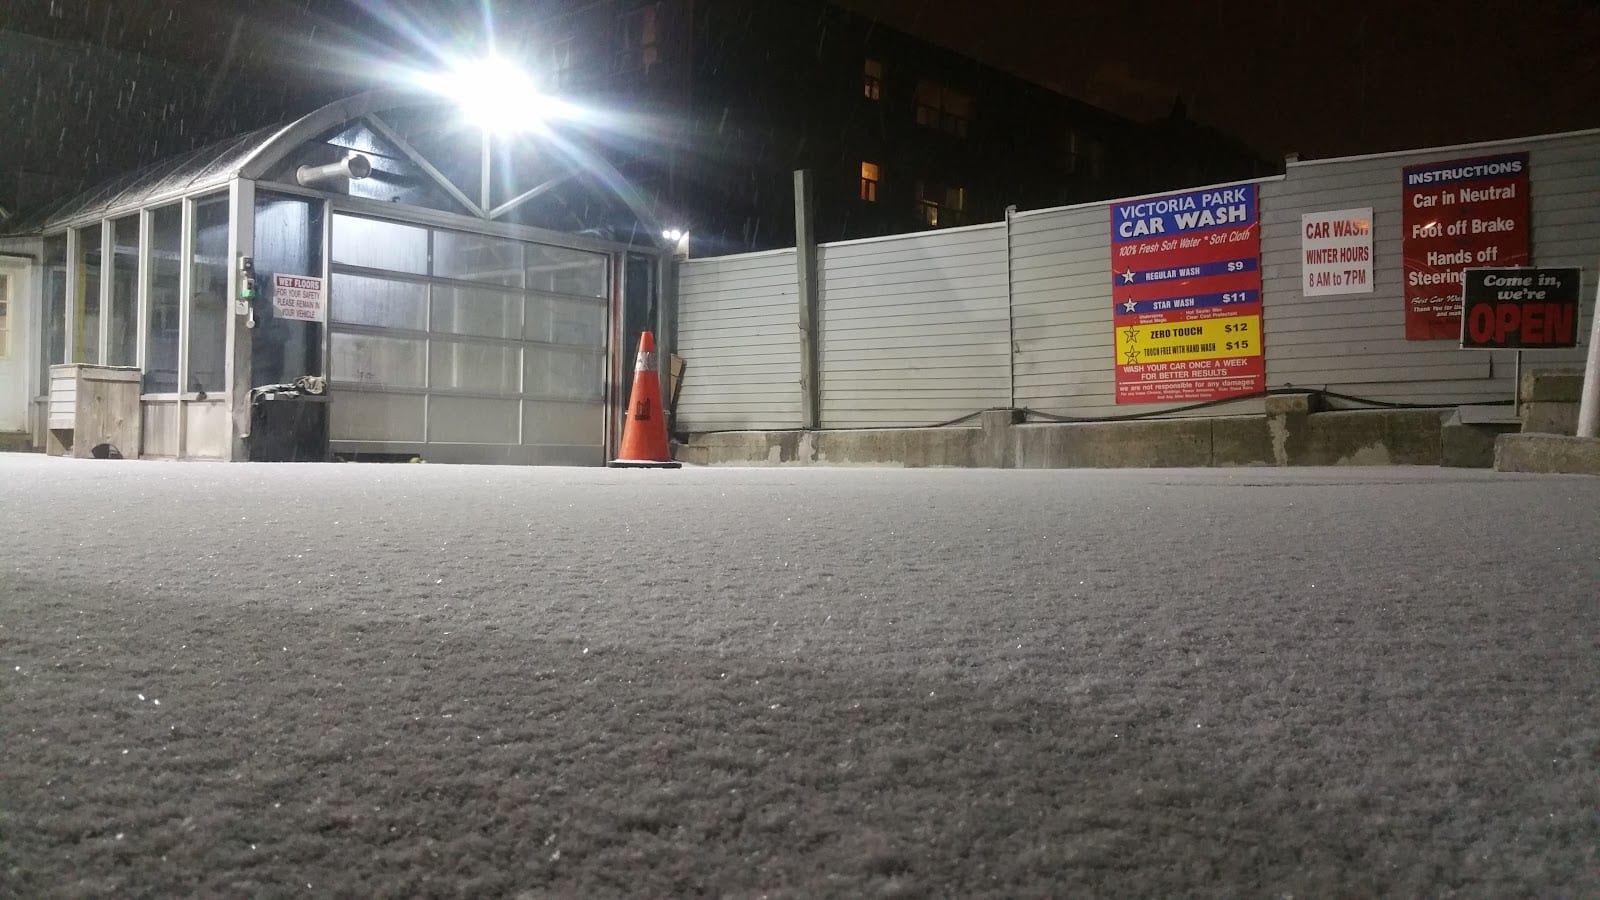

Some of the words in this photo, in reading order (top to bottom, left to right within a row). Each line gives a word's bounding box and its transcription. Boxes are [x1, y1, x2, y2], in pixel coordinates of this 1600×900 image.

[1408, 160, 1522, 184] INSTRUCTIONS
[1120, 196, 1196, 219] VICTORIA
[1202, 188, 1246, 207] PARK
[1413, 194, 1436, 208] Car
[1442, 190, 1455, 205] in
[1460, 184, 1516, 203] Neutral
[1119, 217, 1165, 238] CAR
[1174, 204, 1246, 230] WASH
[1306, 222, 1330, 240] CAR
[1333, 220, 1369, 237] WASH
[1412, 224, 1442, 239] Foot
[1447, 220, 1468, 236] off
[1472, 217, 1514, 234] Brake
[1119, 245, 1137, 257] 100%
[1138, 241, 1158, 254] Fresh
[1160, 240, 1178, 251] Soft
[1180, 238, 1201, 249] Water
[1209, 233, 1226, 245] Soft
[1229, 230, 1250, 242] Cloth
[1306, 248, 1338, 265] WINTER
[1340, 246, 1369, 263] HOURS
[1427, 250, 1472, 266] Hands
[1477, 246, 1498, 262] off
[1146, 269, 1176, 281] REGULAR
[1179, 267, 1200, 277] WASH
[1228, 261, 1244, 272] $9
[1309, 273, 1314, 287] 8
[1317, 271, 1331, 287] AM
[1333, 272, 1341, 286] to
[1344, 269, 1366, 285] 7PM
[1409, 268, 1464, 286] Steering
[279, 278, 292, 287] WET
[294, 279, 319, 290] FLOORS
[1483, 275, 1532, 287] Come
[1537, 274, 1562, 287] in,
[276, 288, 287, 296] FOR
[288, 290, 301, 298] YOUR
[302, 291, 320, 300] SAFETY
[277, 298, 295, 307] PLEASE
[296, 299, 314, 308] REMAIN
[1153, 300, 1171, 310] STAR
[1174, 298, 1194, 308] WASH
[1222, 292, 1246, 303] $11
[1498, 288, 1546, 300] we're
[282, 308, 295, 316] YOUR
[296, 310, 315, 319] VEHICLE
[1150, 329, 1171, 340] ZERO
[1173, 326, 1203, 337] TOUCH
[1225, 323, 1248, 333] $12
[1469, 303, 1573, 344] OPEN
[1144, 348, 1160, 357] TOUCH
[1161, 346, 1171, 355] FREE
[1172, 345, 1185, 354] WITH
[1186, 344, 1200, 353] HAND
[1201, 343, 1216, 352] WASH
[1225, 340, 1249, 350] $15
[1123, 363, 1144, 373] WASH
[1146, 362, 1167, 372] YOUR
[1170, 361, 1186, 370] CAR
[1189, 360, 1211, 369] ONCE
[1223, 358, 1248, 367] WEEK
[1141, 372, 1157, 381] FOR
[1160, 370, 1188, 380] BETTER
[1192, 369, 1228, 378] RESULTS
[1155, 382, 1192, 391] responsible
[1222, 379, 1255, 387] damages
